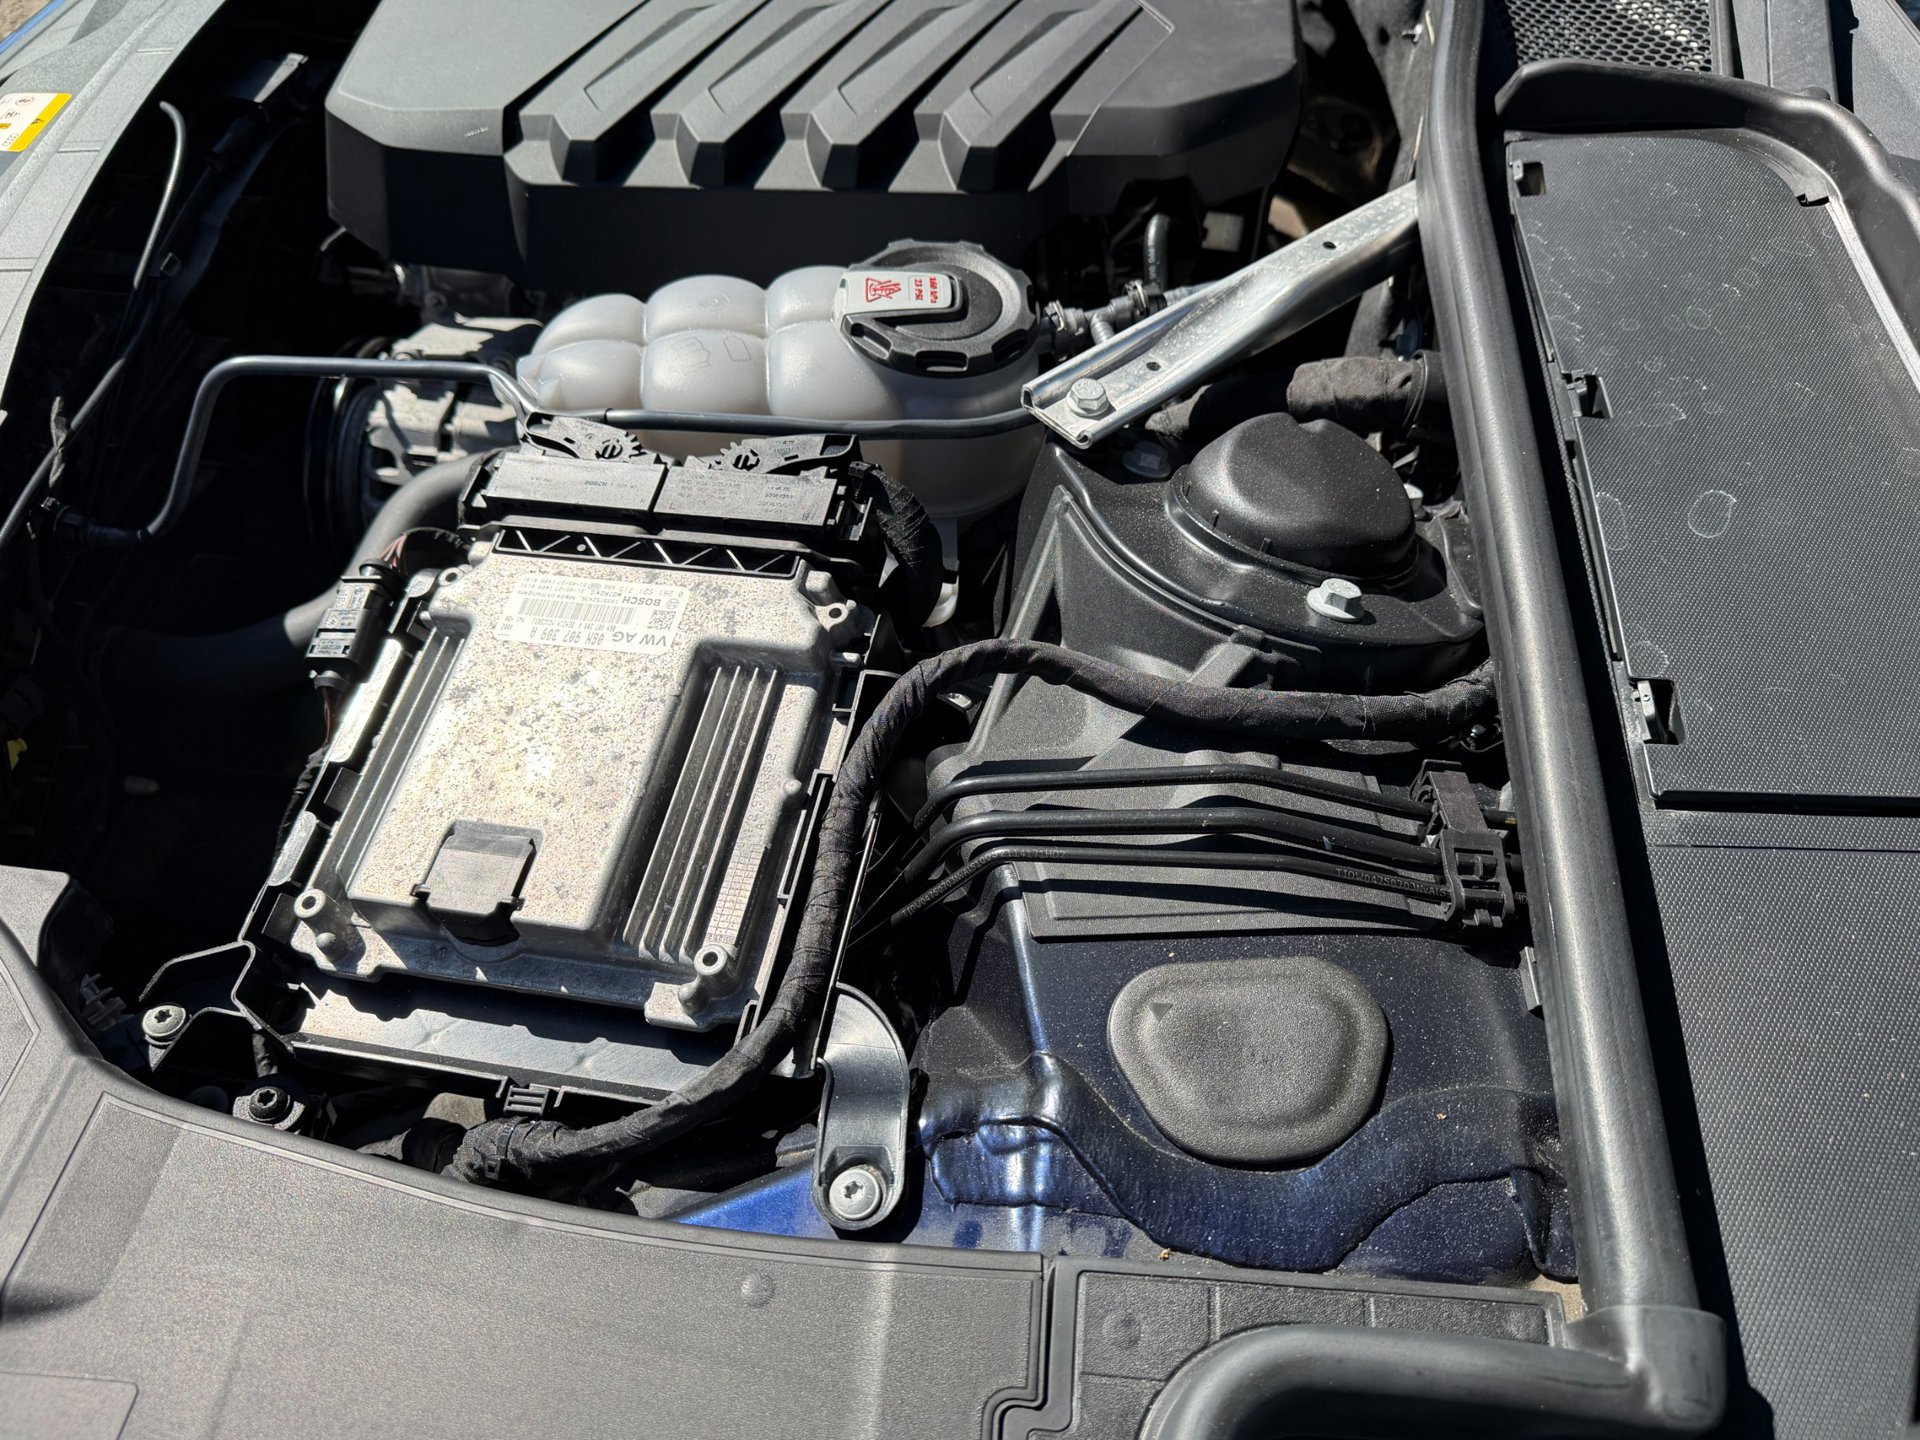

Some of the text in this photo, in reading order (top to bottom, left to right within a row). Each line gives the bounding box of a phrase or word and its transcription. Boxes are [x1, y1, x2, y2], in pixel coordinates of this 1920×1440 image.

[621, 595, 661, 606] BOSCH
[539, 627, 560, 641] 309
[561, 629, 582, 643] 907
[609, 630, 637, 644] AG
[638, 633, 668, 646] VW
